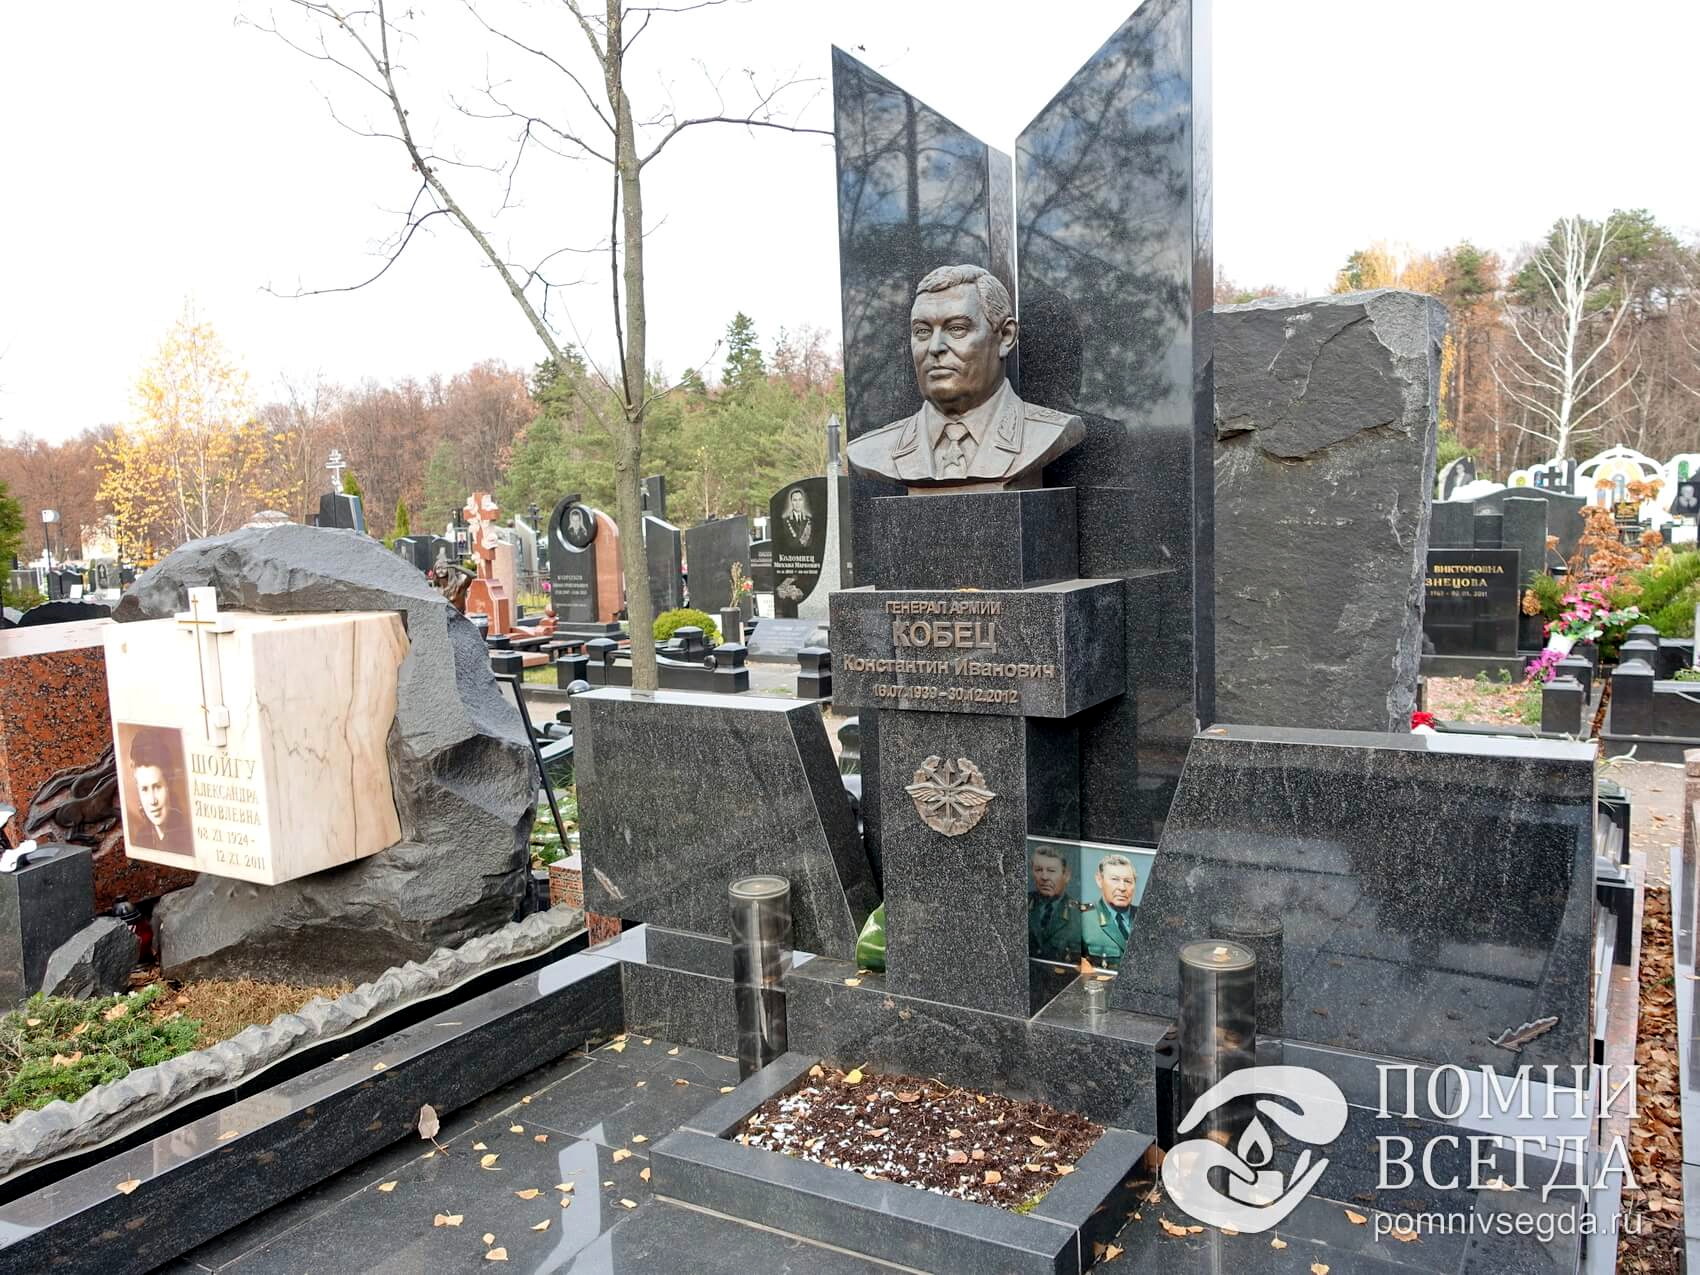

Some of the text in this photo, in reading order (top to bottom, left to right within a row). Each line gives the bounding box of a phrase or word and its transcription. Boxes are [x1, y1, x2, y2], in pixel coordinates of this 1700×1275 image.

[1424, 578, 1488, 588] ЗНЕЦОВА
[885, 601, 1001, 615] ГЕНЕРАЛ АРМИИ
[892, 621, 998, 652] КОБЕЦ
[843, 655, 1056, 678] Константин Иванович
[191, 752, 256, 780] ШОЙГУ
[193, 779, 259, 804] АЛЕКСАНДРА
[195, 800, 261, 826] ЯКОВЛЕВНА
